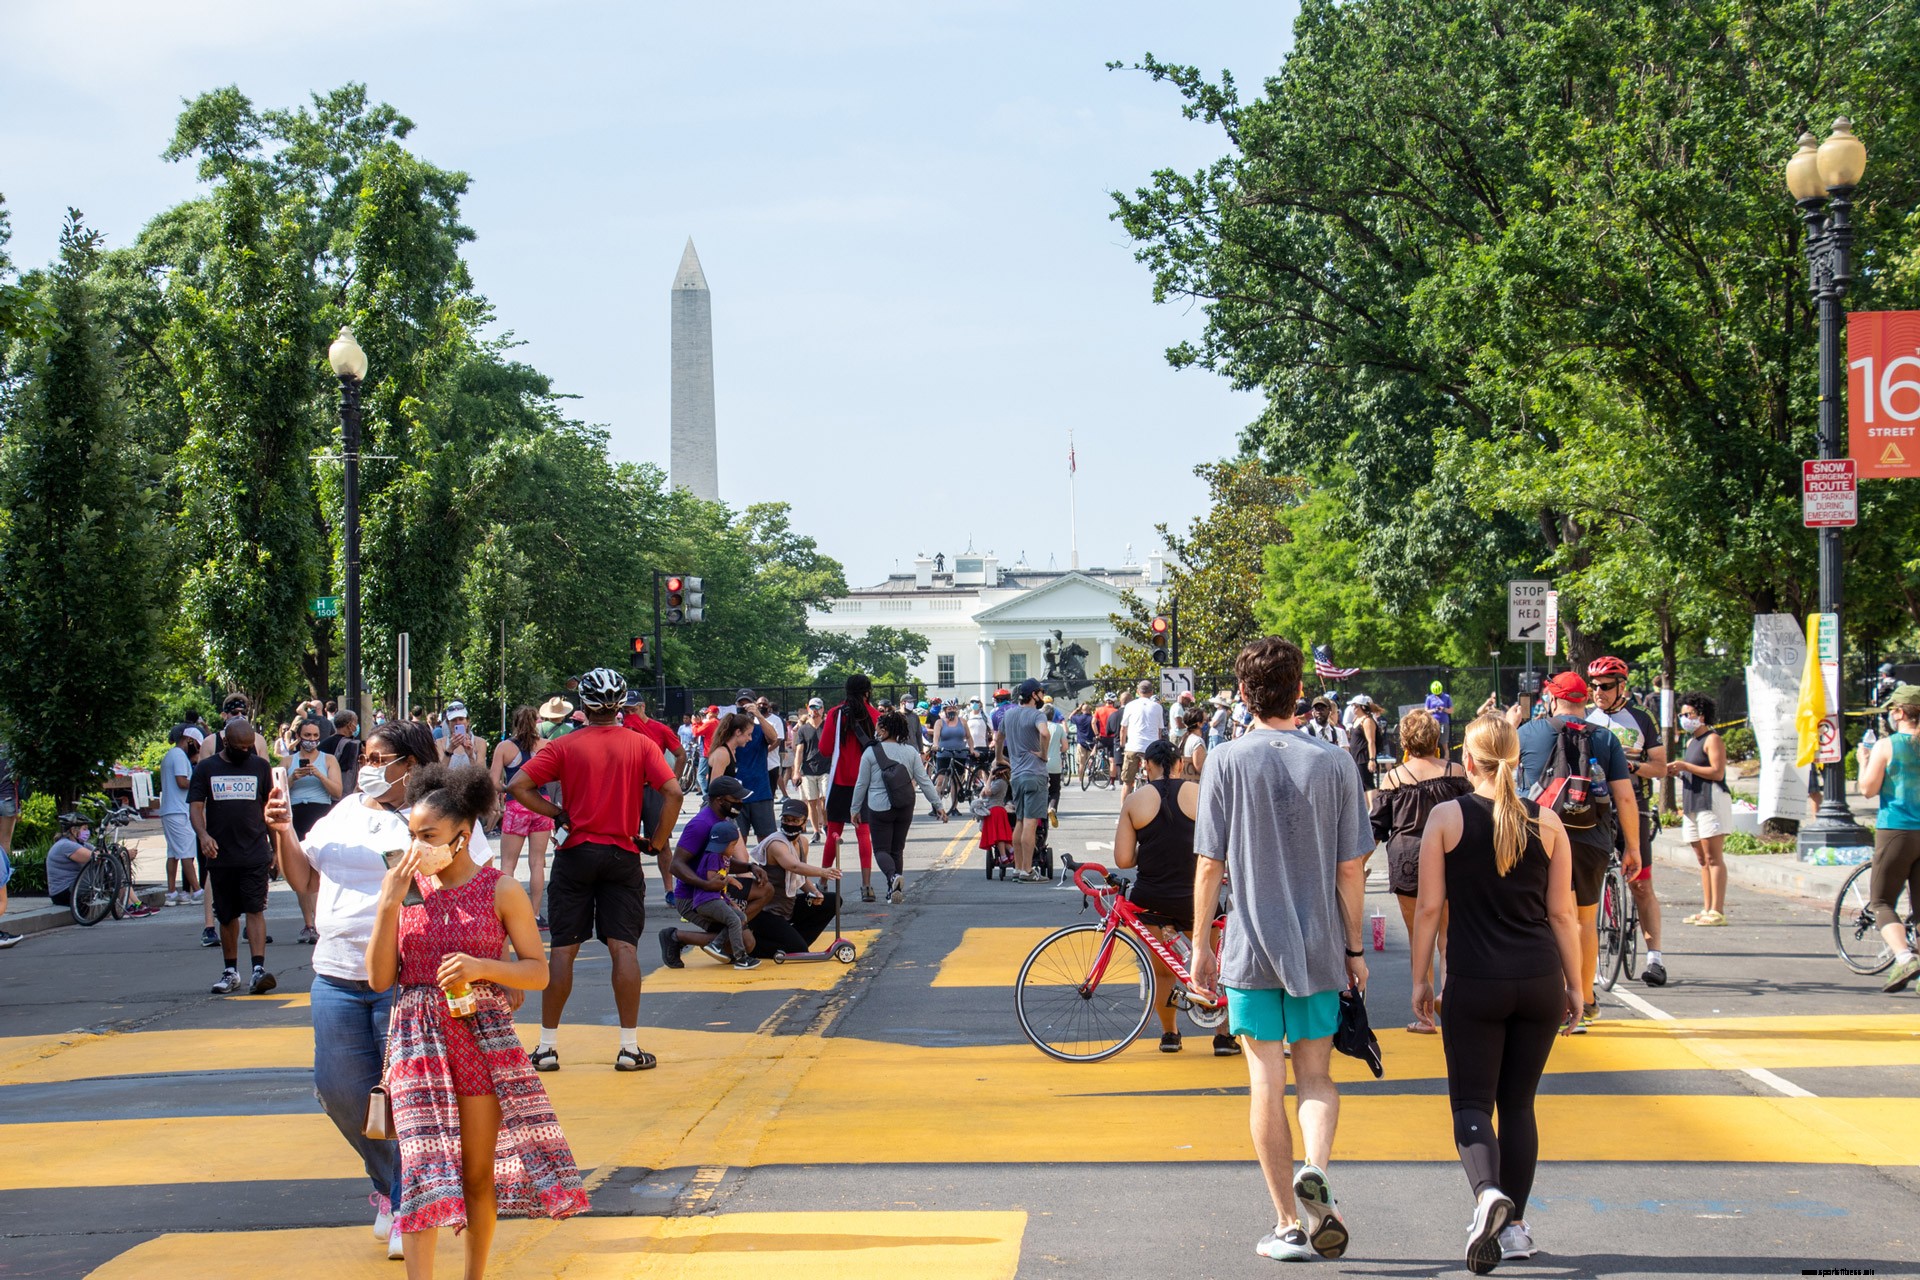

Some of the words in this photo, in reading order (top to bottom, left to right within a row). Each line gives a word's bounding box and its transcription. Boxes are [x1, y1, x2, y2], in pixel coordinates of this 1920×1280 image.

[1868, 427, 1915, 437] STREET
[1813, 463, 1846, 473] SNOW
[1806, 473, 1853, 481] EMERGENCY
[1810, 481, 1850, 491] ROUTE
[1821, 492, 1853, 501] PARKING
[1816, 502, 1844, 510] DURING
[1807, 511, 1853, 520] EMERGENCY
[1515, 586, 1544, 596] STOP
[317, 600, 325, 609] H
[318, 609, 337, 617] 1500
[1518, 609, 1540, 618] RED
[213, 782, 225, 793] I'M
[233, 782, 243, 792] SO
[246, 782, 255, 792] DC
[1129, 919, 1191, 979] SPECIALIZED
